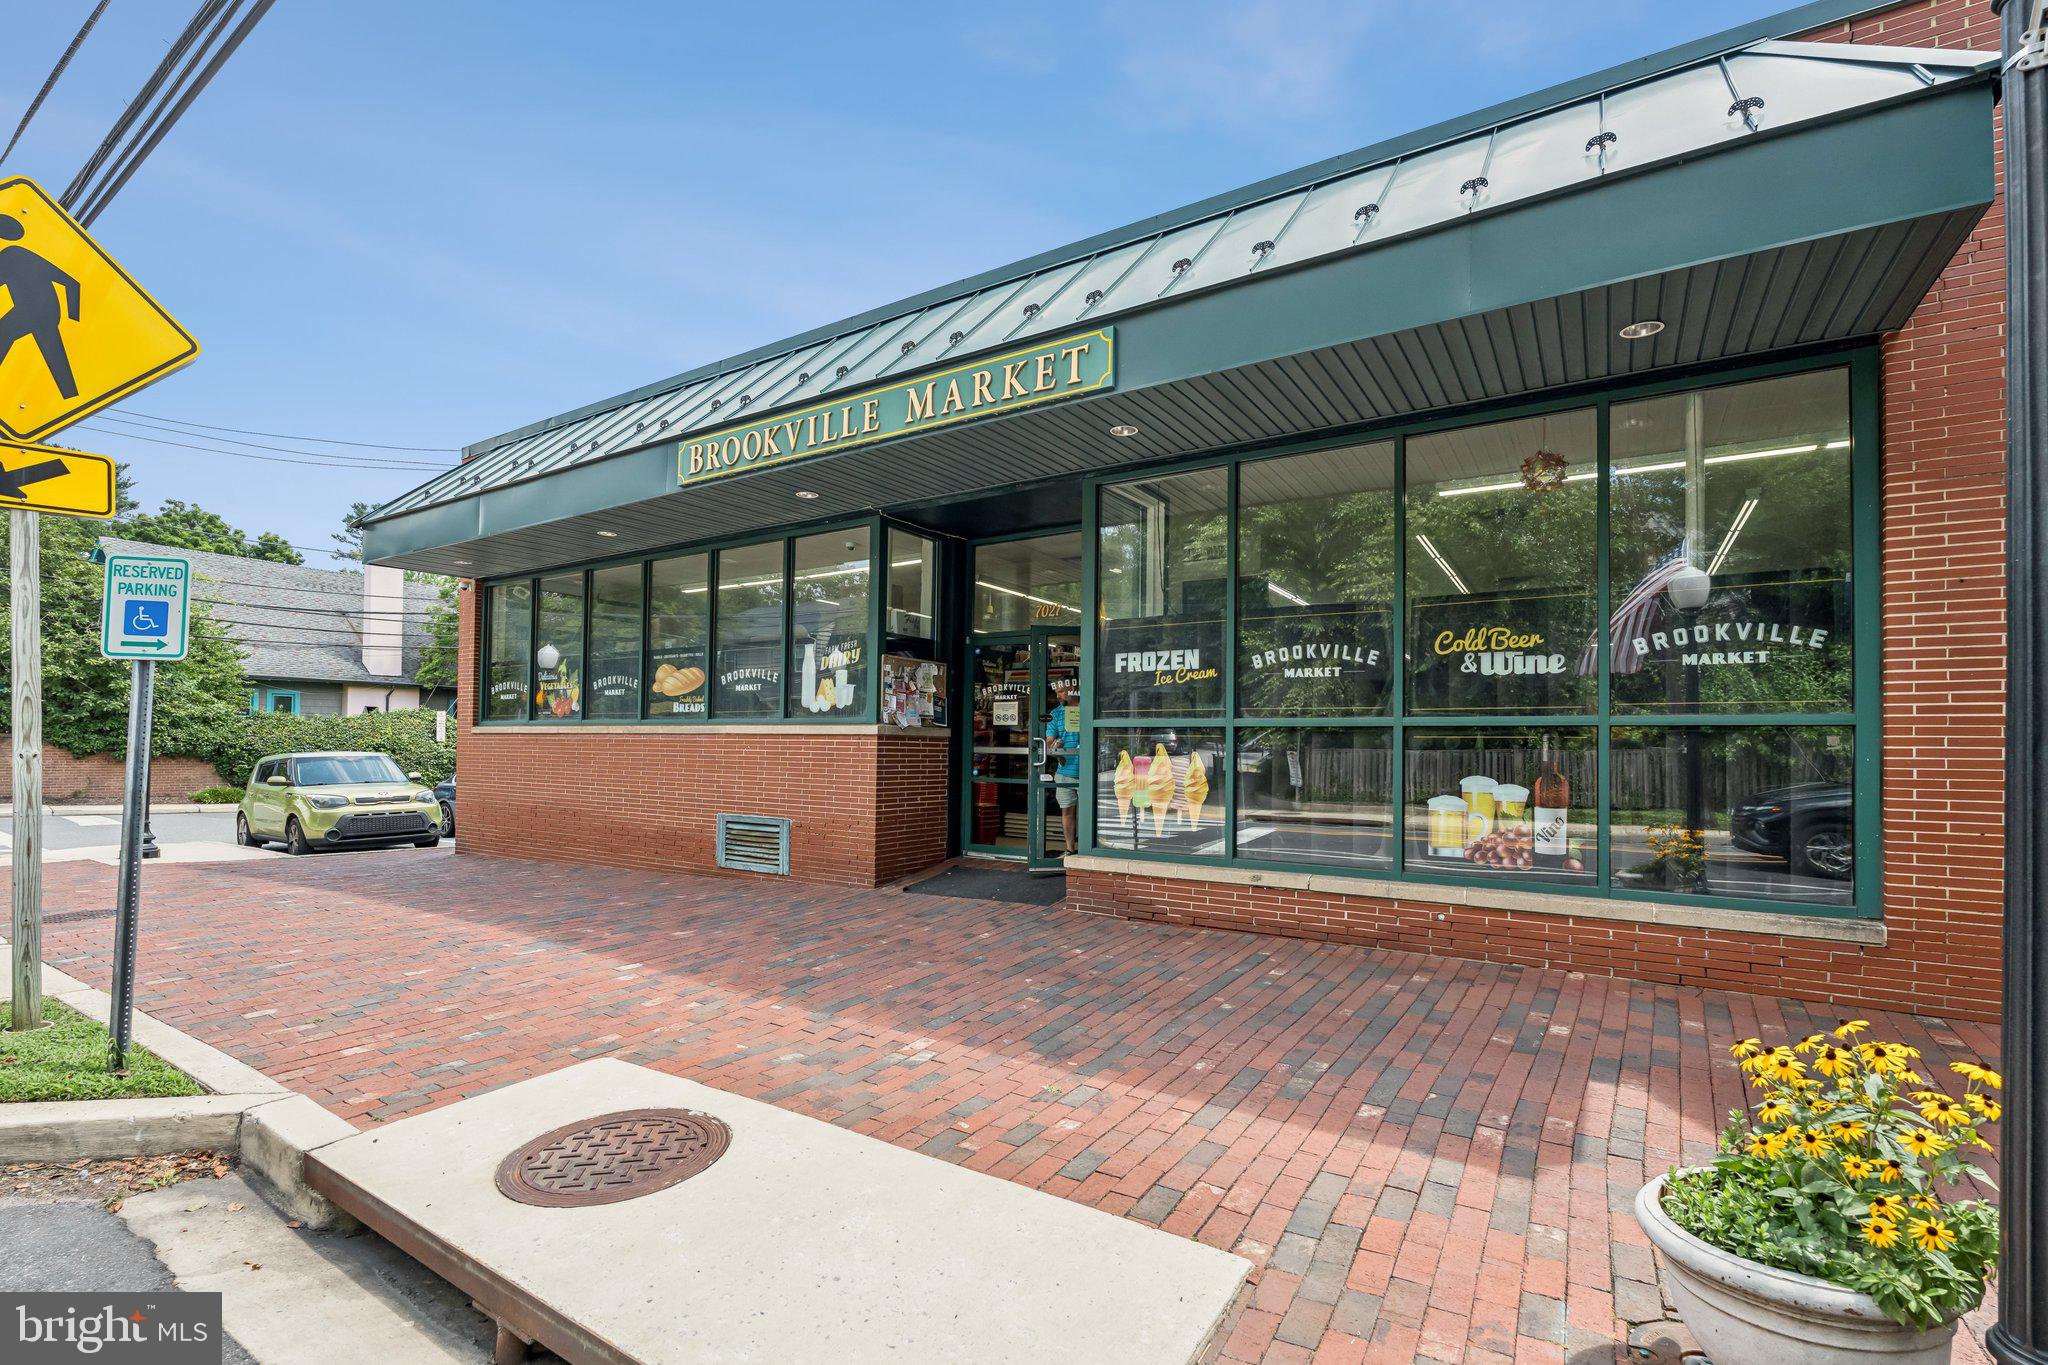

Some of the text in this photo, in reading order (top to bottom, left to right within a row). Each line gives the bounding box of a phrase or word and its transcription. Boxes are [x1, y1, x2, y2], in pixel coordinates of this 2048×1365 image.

[688, 342, 1090, 476] BROOKVILLE MARKET
[113, 564, 184, 580] RESERVED
[117, 582, 178, 597] PARKING
[1035, 604, 1062, 618] 7027
[1434, 627, 1544, 655] Cold Beer
[1632, 622, 1829, 656] BROOKVILLE
[1115, 649, 1200, 673] FROZEN
[1251, 644, 1380, 669] BROOKVILLE
[1682, 651, 1770, 666] MARKET
[720, 668, 779, 686] BROOKVILLE
[1154, 667, 1218, 686] Ice Cream
[1284, 667, 1342, 678] MARKET
[491, 681, 528, 695] BROOKVILLE
[593, 675, 638, 691] BROOKVILLE
[735, 683, 762, 692] MARKET
[982, 683, 1031, 696] BROOKVILLE
[604, 688, 626, 696] MARKET
[672, 701, 705, 713] BREADS
